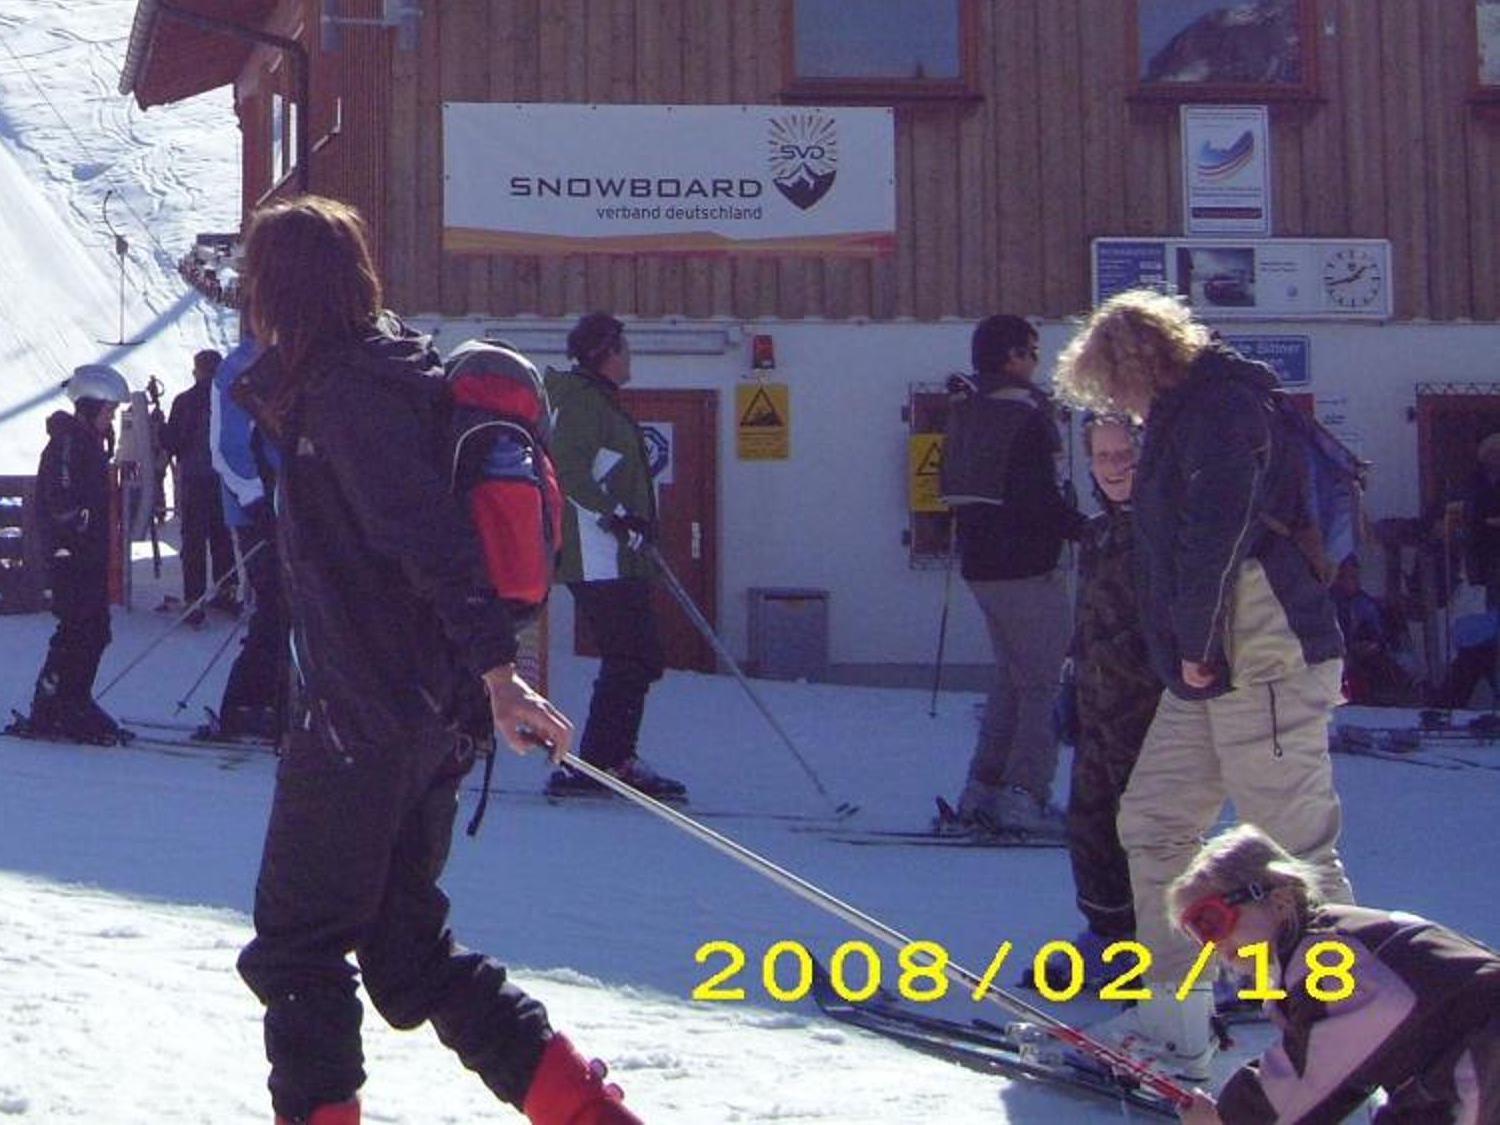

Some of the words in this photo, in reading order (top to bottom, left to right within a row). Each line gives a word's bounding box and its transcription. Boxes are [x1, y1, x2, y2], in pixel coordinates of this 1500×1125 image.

[781, 145, 825, 160] SVD
[510, 176, 763, 198] SNOWBOARD
[597, 206, 661, 221] verband
[665, 206, 763, 221] deutschland
